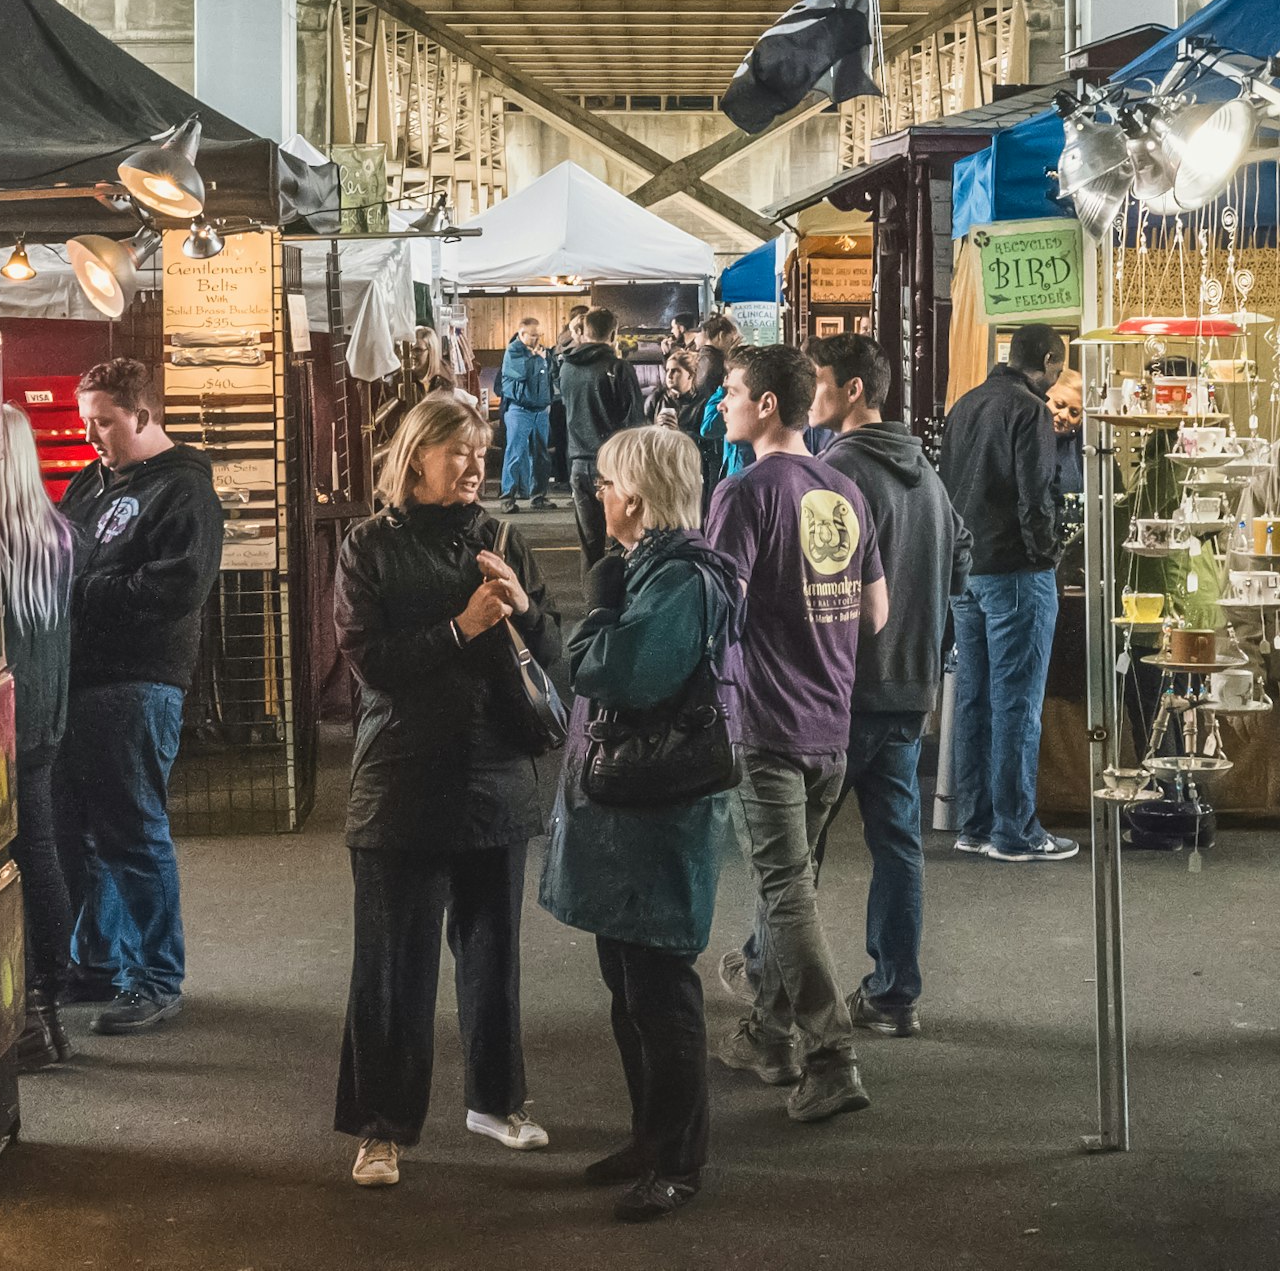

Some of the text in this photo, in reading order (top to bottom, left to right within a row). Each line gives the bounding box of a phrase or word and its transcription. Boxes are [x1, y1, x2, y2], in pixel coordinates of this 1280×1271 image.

[995, 237, 1062, 254] RECYCLED
[167, 262, 267, 275] Gentlemen's
[988, 256, 1071, 290] BIRD
[197, 279, 238, 291] Belts
[206, 295, 229, 303] With
[1015, 291, 1072, 307] FEEDERS
[166, 305, 269, 315] Solid Brass Buckles
[737, 310, 774, 319] CLINICAL
[205, 318, 229, 328] $35
[206, 379, 232, 389] $40
[212, 475, 232, 485] 50
